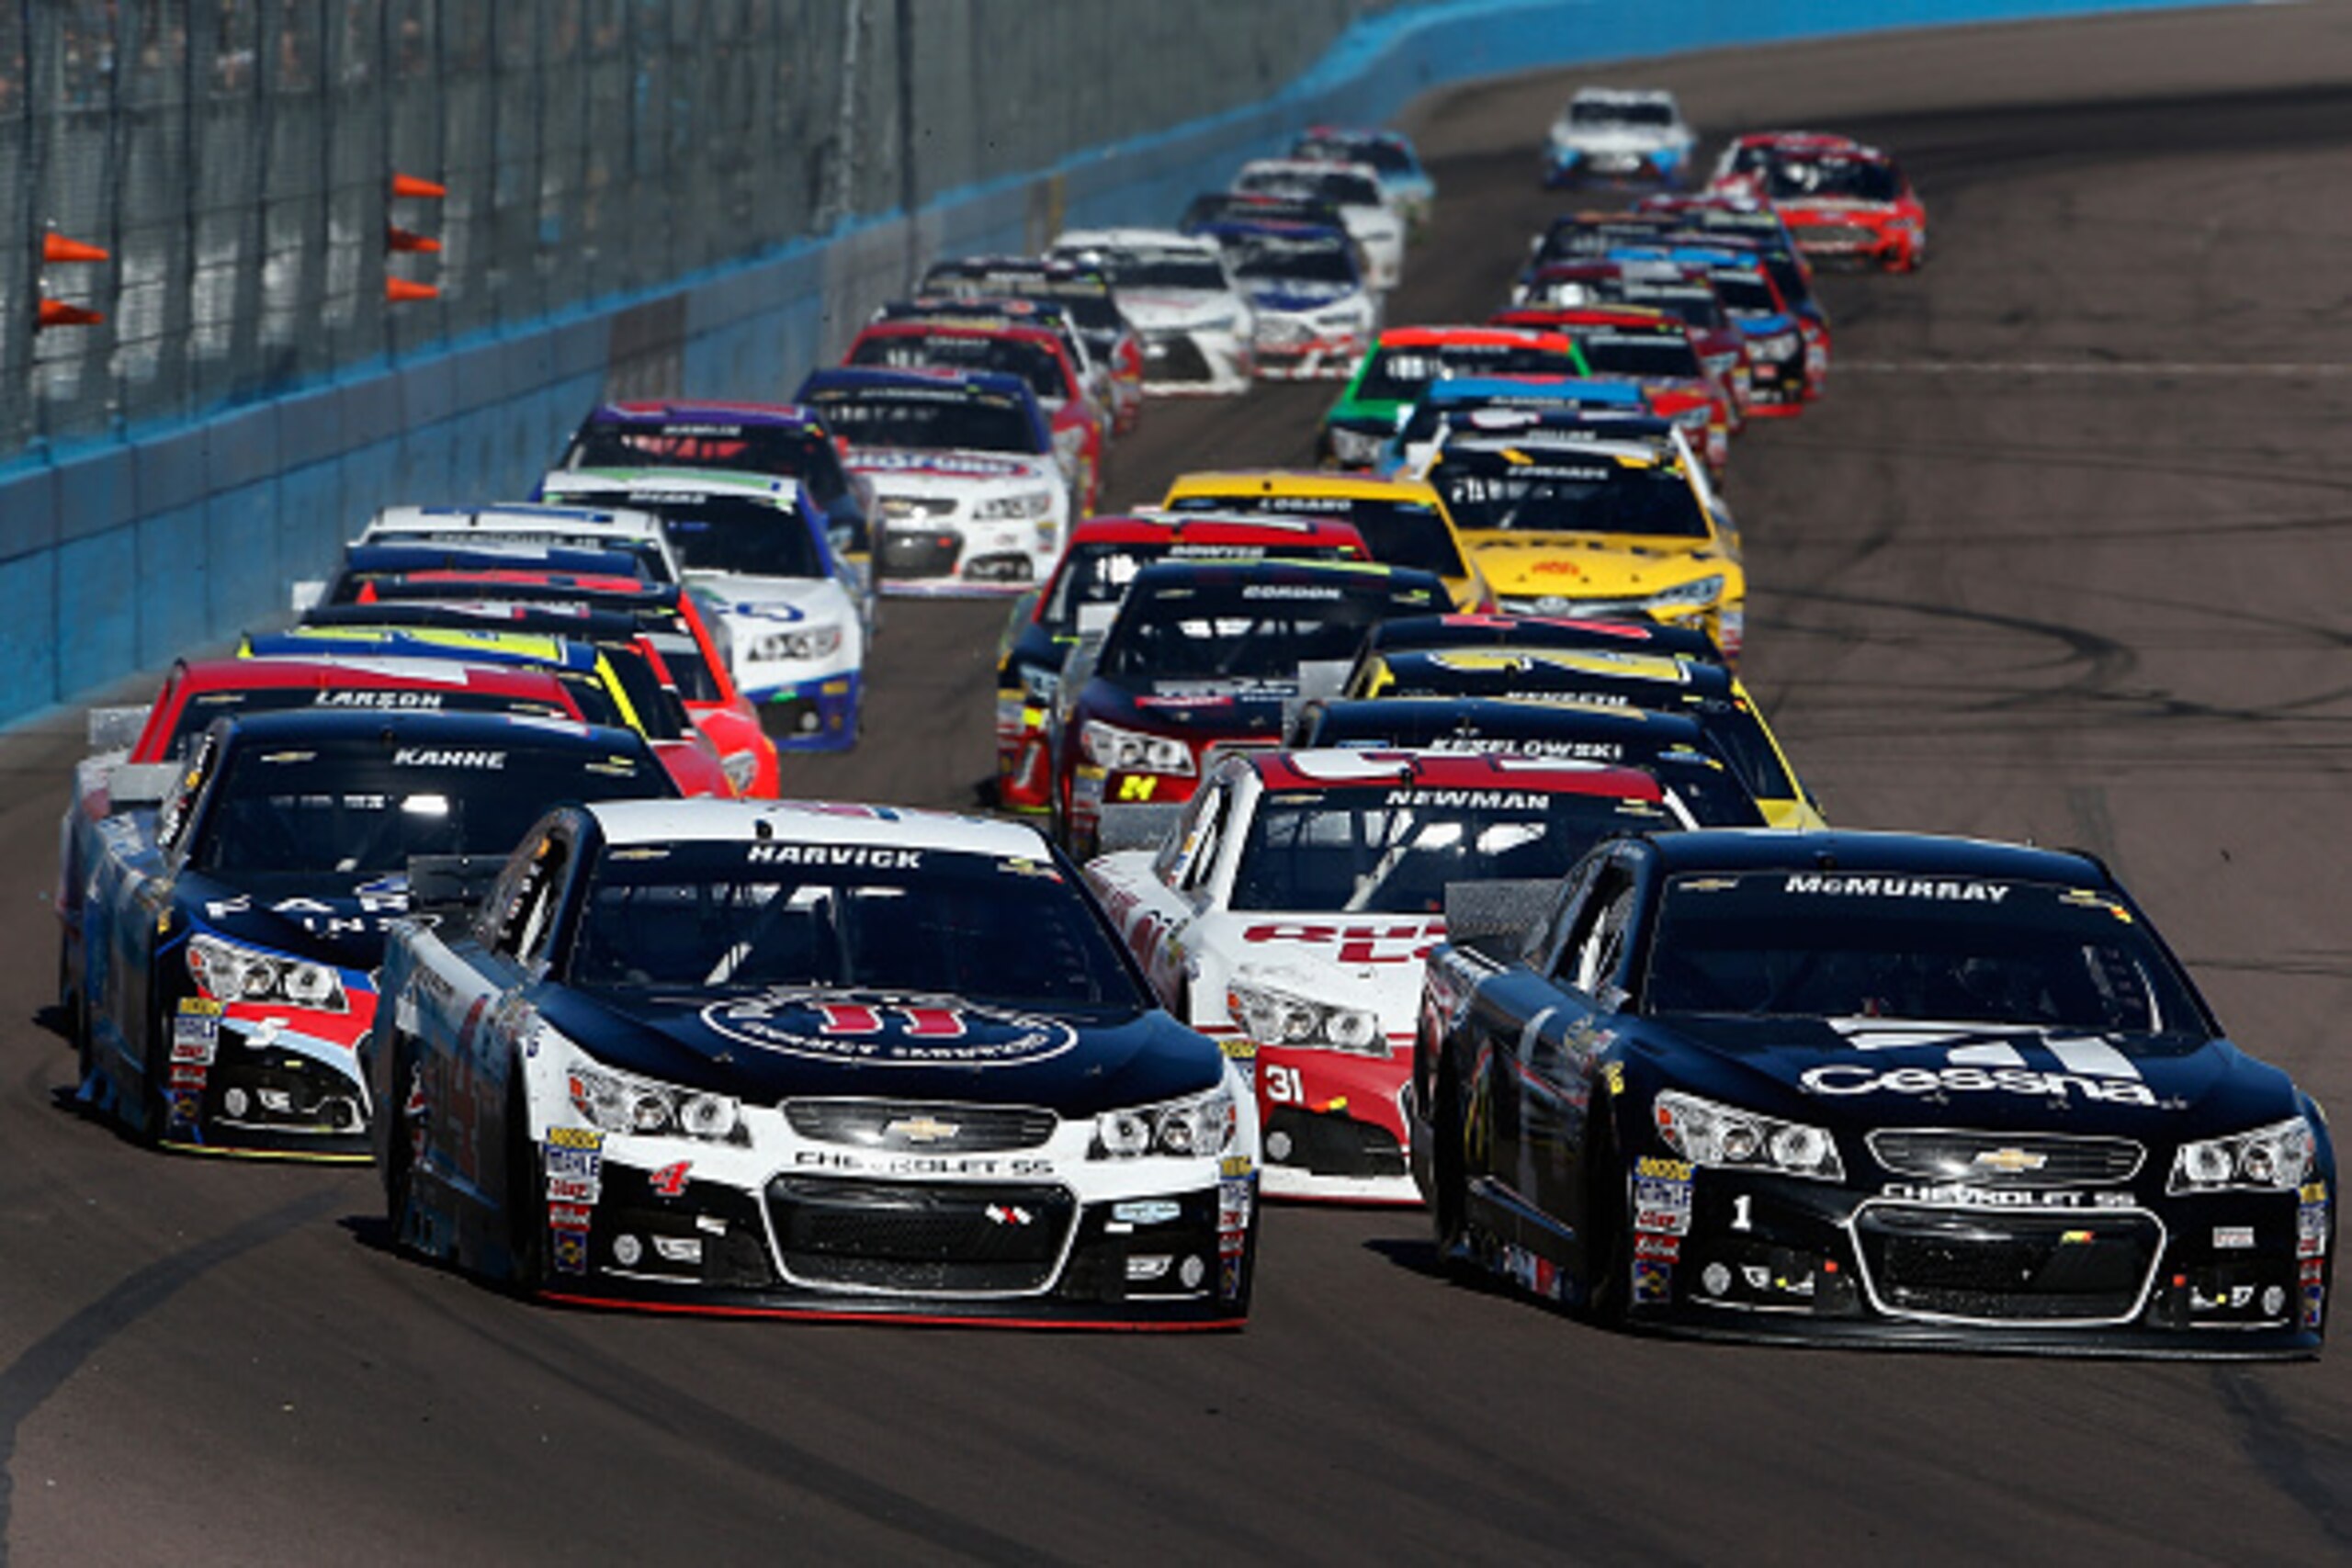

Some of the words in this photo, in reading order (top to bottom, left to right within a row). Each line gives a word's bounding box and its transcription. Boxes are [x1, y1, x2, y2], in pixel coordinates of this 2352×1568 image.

[315, 692, 443, 707] LARSON
[1386, 791, 1549, 810] NEWMAN
[748, 847, 922, 868] HARVICK
[1785, 875, 2009, 903] McMURRAY
[1266, 1065, 1304, 1105] 31
[1800, 1066, 2156, 1106] Cessna
[650, 1161, 692, 1195] 4
[1731, 1195, 1752, 1231] 1
